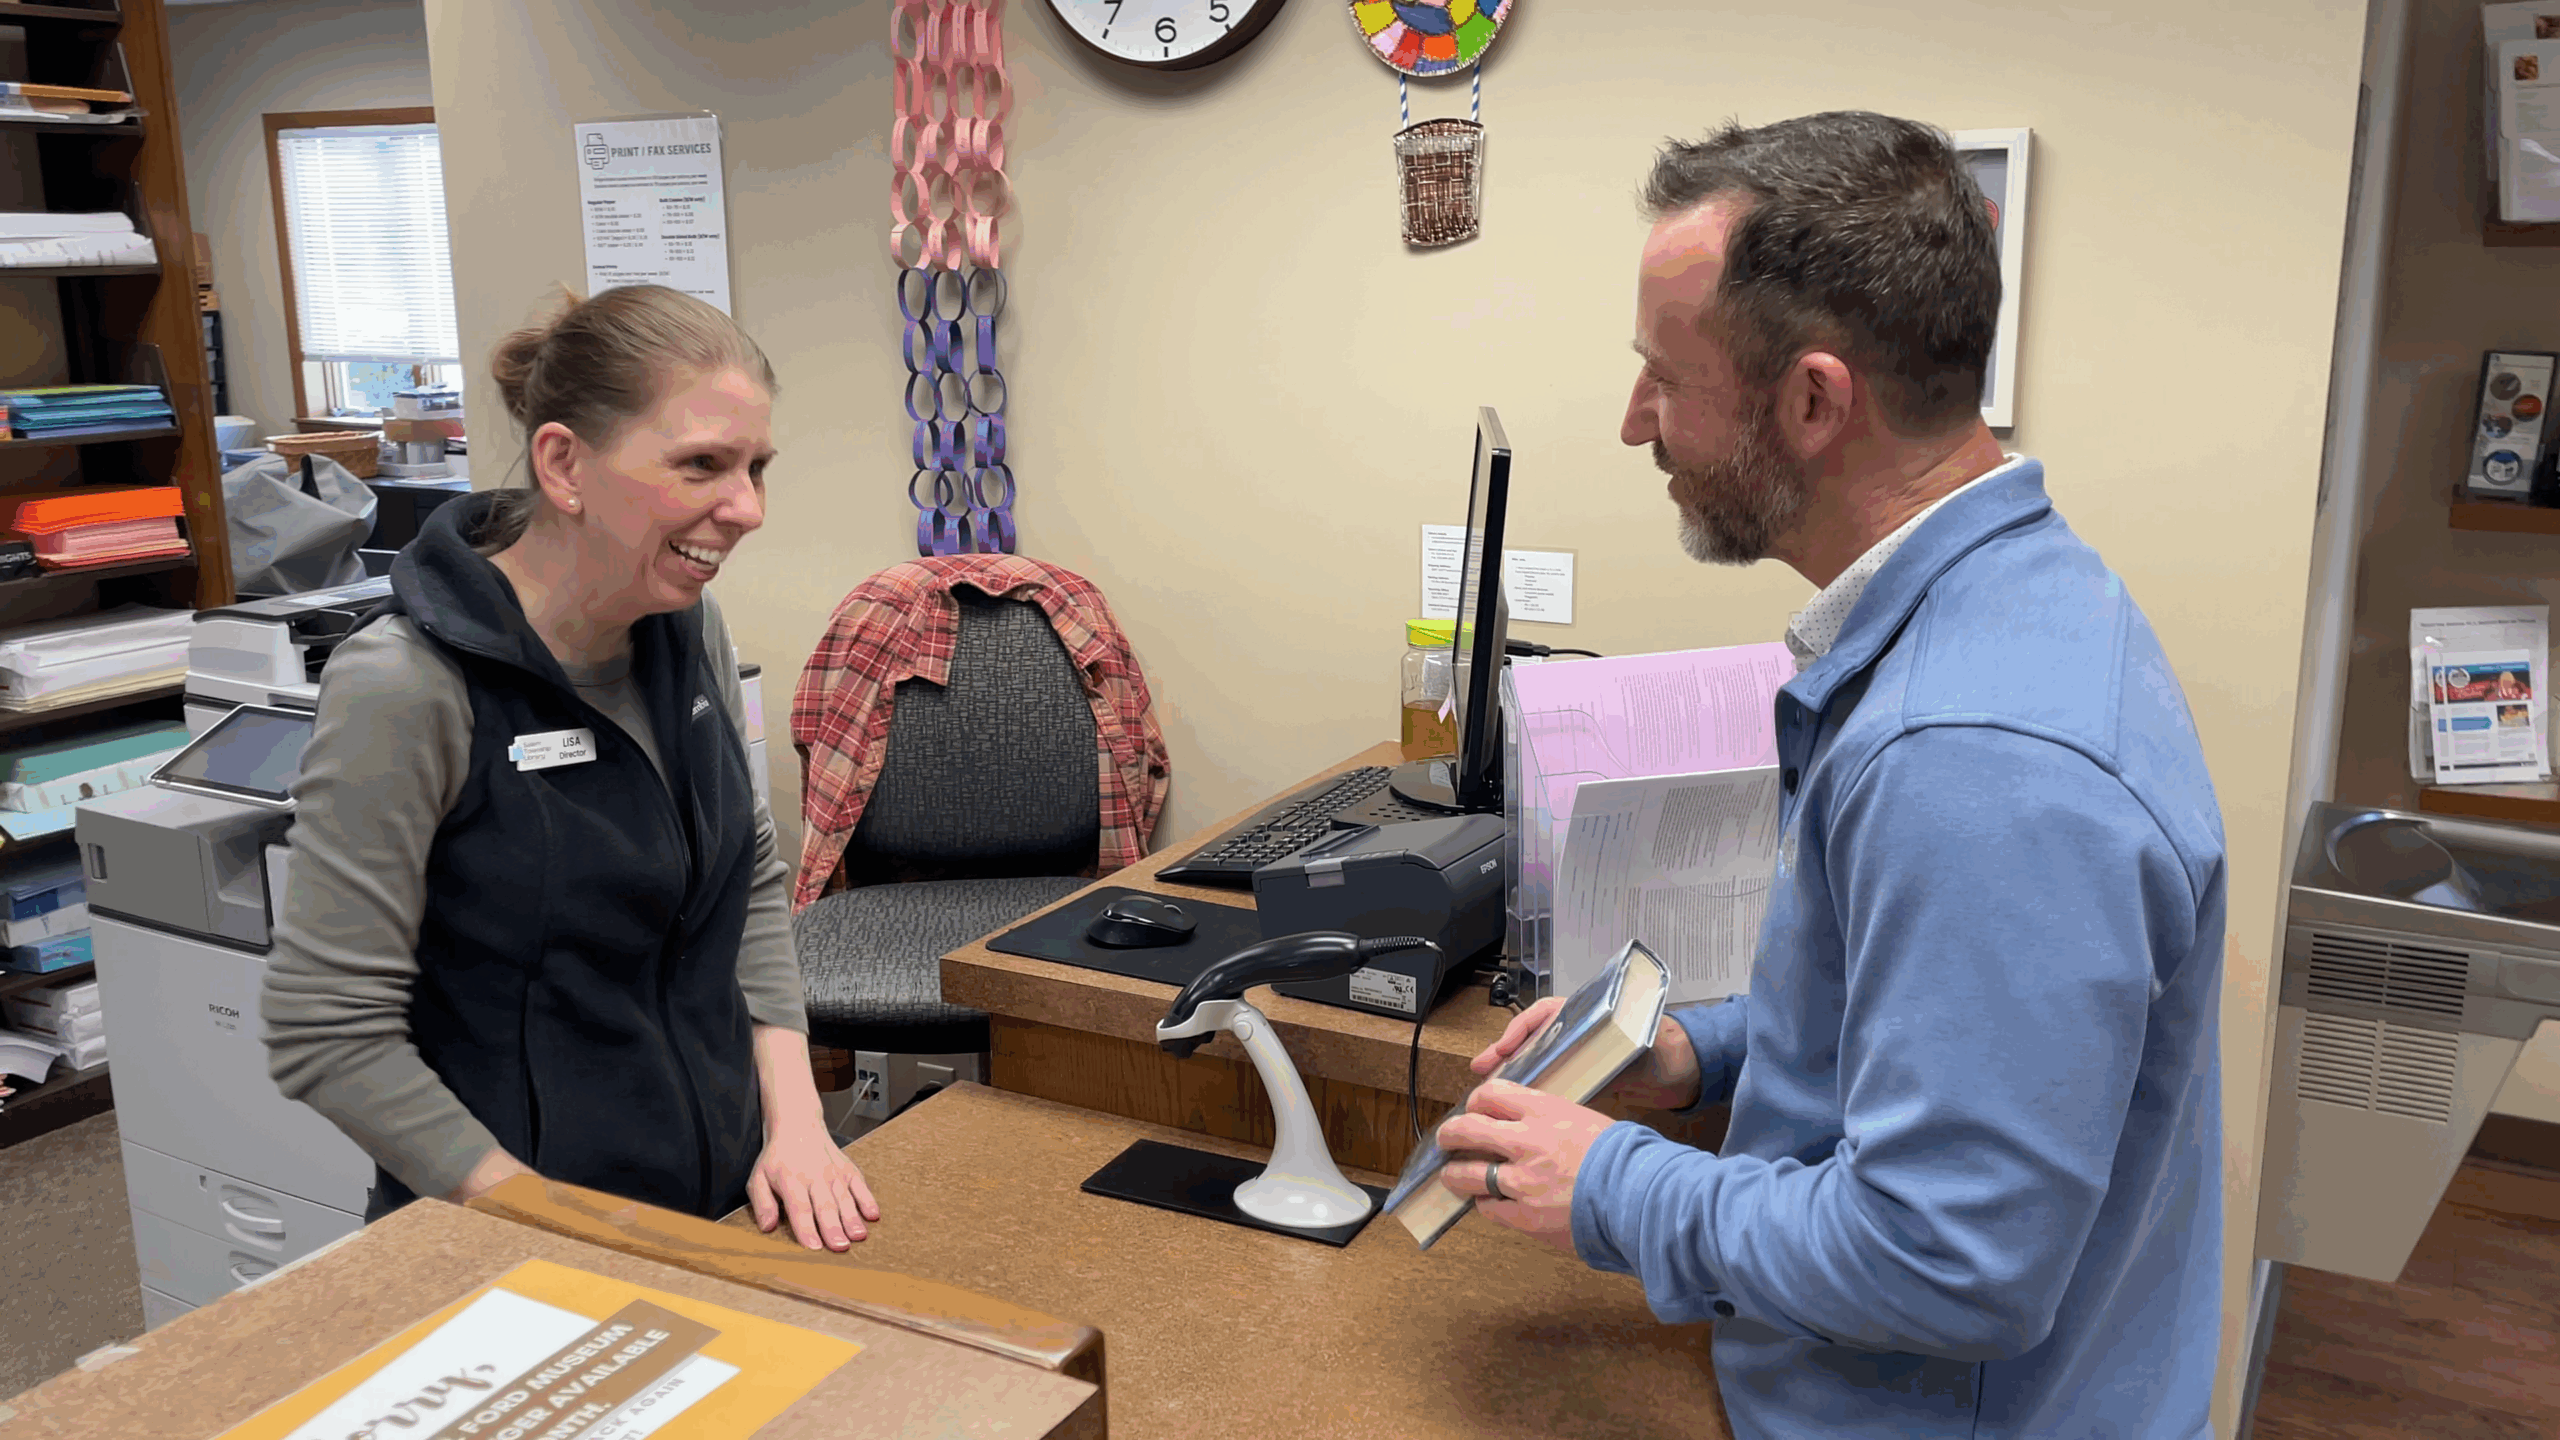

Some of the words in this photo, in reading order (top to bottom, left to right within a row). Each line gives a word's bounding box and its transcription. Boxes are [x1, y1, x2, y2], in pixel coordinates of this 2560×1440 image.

[1104, 0, 1123, 25] 7
[1209, 0, 1230, 23] 5
[1154, 17, 1178, 43] 6
[611, 146, 639, 158] PRINT
[647, 145, 665, 156] FAX
[667, 143, 711, 155] SERVICES
[563, 736, 581, 748] LISA
[559, 749, 587, 760] Director
[1480, 858, 1498, 875] EPSON
[208, 1003, 240, 1019] RICOH
[458, 1389, 530, 1434] FORD
[525, 1322, 635, 1390] MUSEUM
[548, 1328, 671, 1409] AVAILABLE
[629, 1378, 686, 1415] AGAIN
